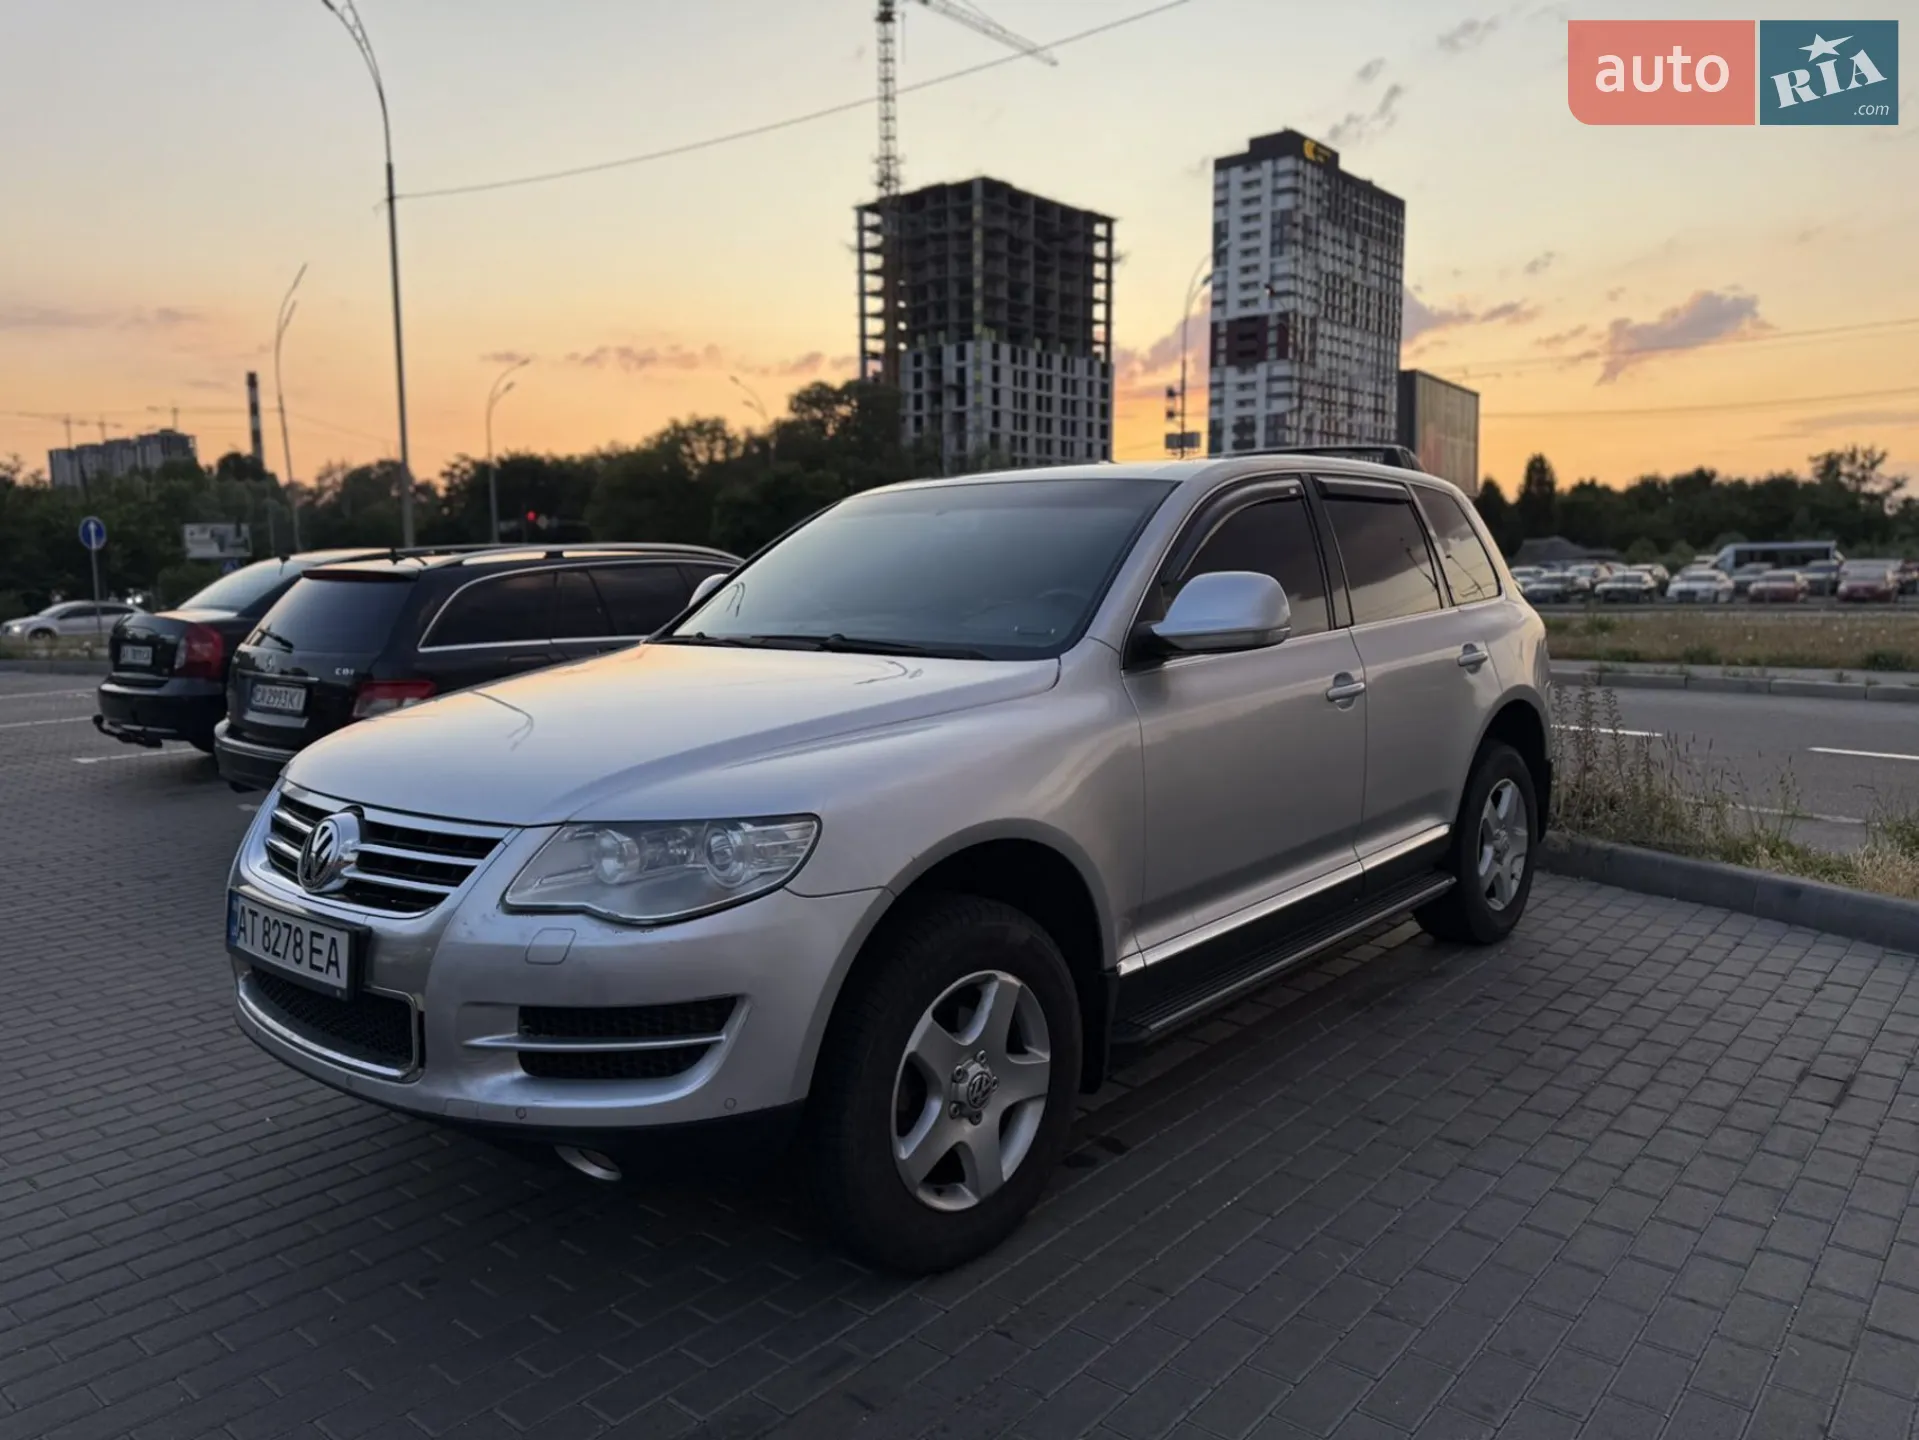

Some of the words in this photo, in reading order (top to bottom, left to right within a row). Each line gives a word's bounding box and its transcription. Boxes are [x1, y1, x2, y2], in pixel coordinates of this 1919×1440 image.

[236, 905, 259, 947] AT
[261, 916, 303, 965] 8278
[308, 930, 341, 979] EA
